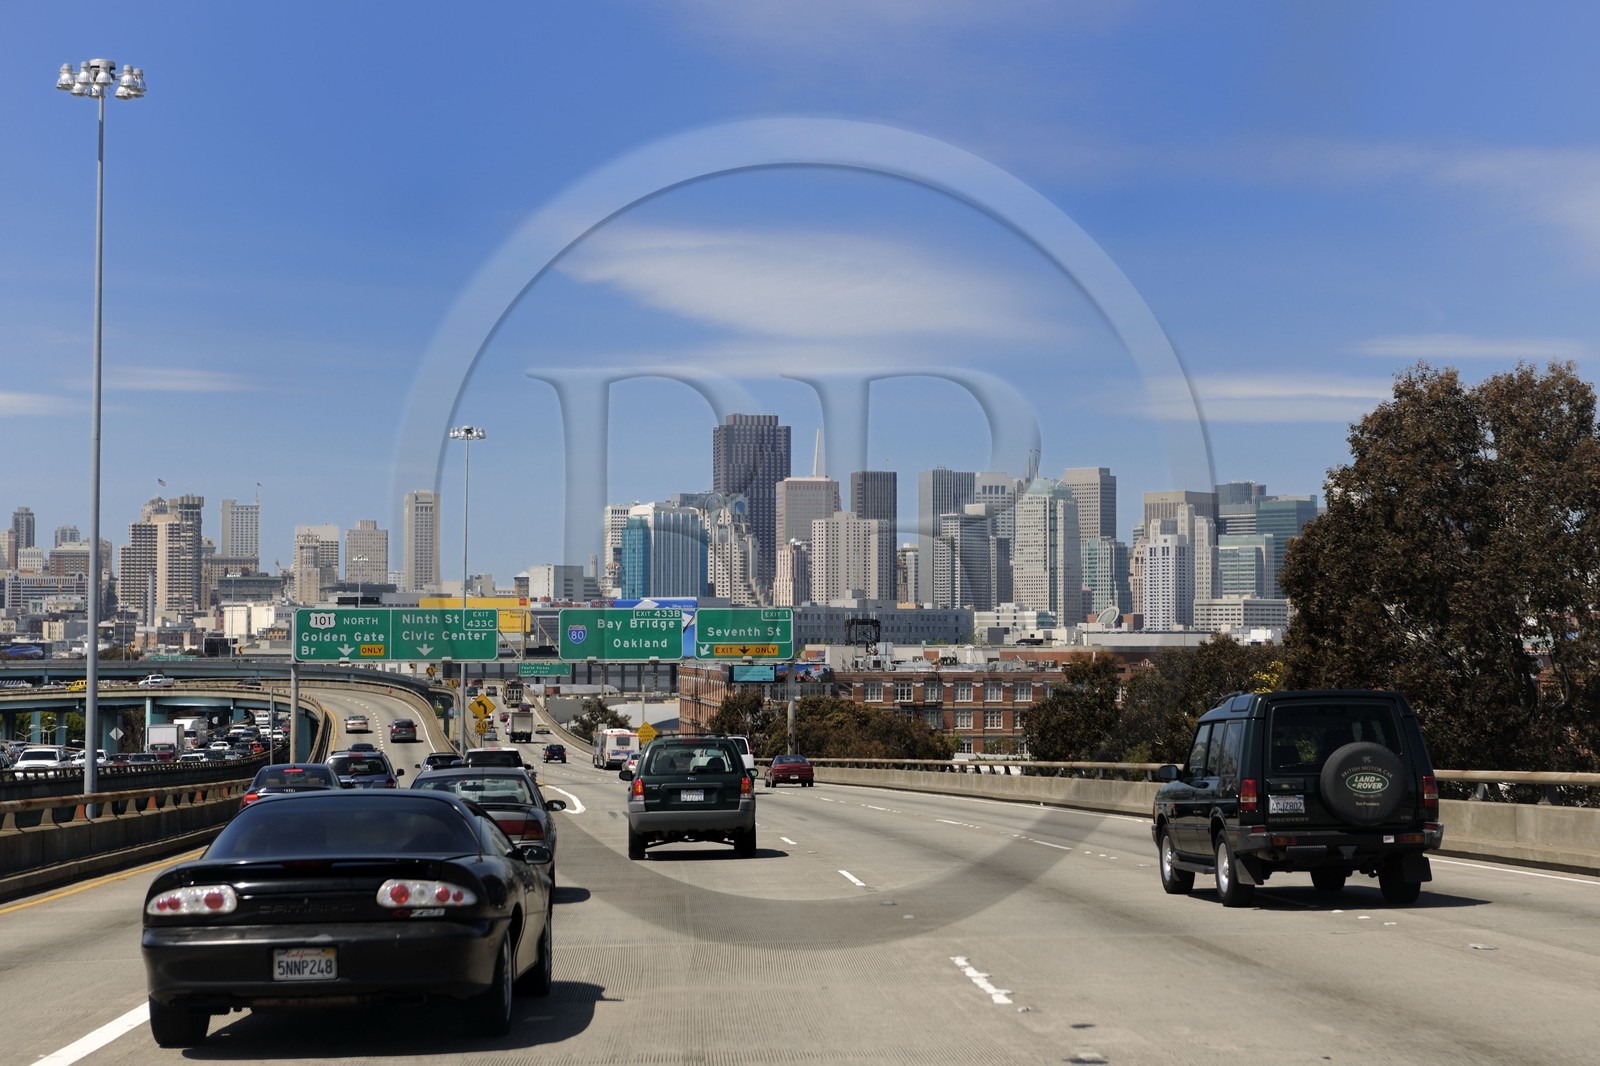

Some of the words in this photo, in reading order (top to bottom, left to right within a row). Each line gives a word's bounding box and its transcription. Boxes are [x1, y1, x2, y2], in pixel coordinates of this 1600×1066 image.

[654, 610, 680, 618] 433B
[314, 616, 332, 626] 101
[343, 617, 379, 625] NORTH
[402, 615, 438, 624] Ninth
[445, 615, 459, 624] St
[467, 620, 494, 628] 433C
[598, 619, 622, 631] Bay
[630, 619, 675, 631] Bridge
[302, 632, 347, 642] Golden
[354, 632, 385, 642] Gate
[402, 631, 434, 641] Civic
[442, 631, 487, 641] Center
[571, 630, 584, 640] 80
[707, 627, 761, 637] Seventh
[767, 627, 781, 637] St
[613, 638, 668, 648] Oakland
[301, 646, 316, 655] Br
[409, 908, 446, 918] Z28
[278, 959, 333, 975] 5NNP248
